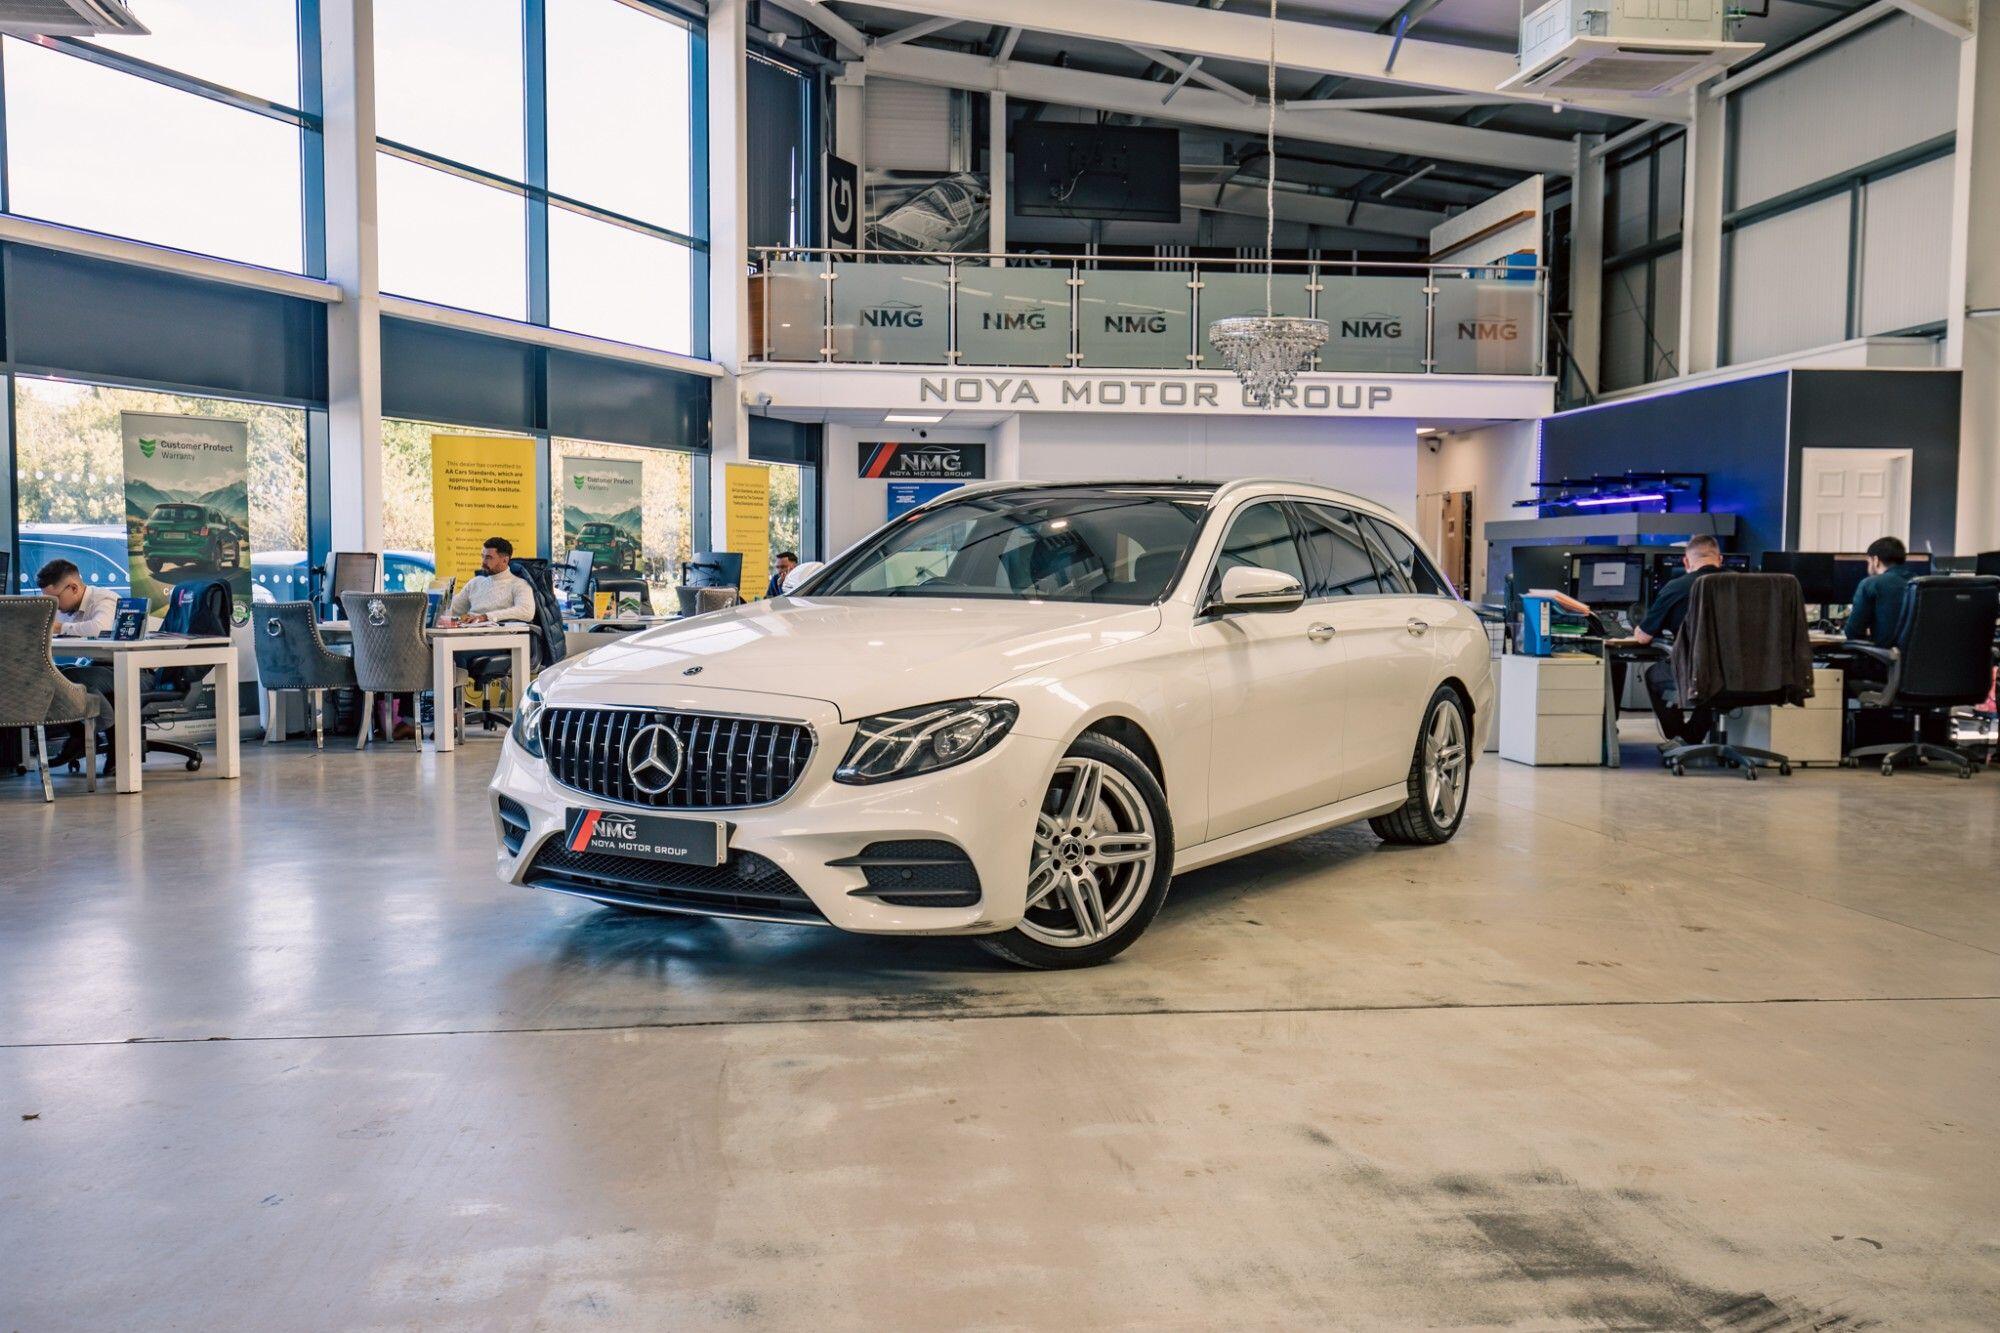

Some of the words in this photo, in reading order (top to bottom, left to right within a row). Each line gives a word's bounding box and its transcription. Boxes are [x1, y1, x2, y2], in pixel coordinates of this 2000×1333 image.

[859, 309, 924, 328] NMG
[982, 312, 1047, 330] NMG
[1104, 315, 1167, 334] NMG
[1341, 320, 1402, 339] NMG
[1457, 322, 1518, 341] NMG
[920, 377, 1040, 404] NOYA
[1062, 380, 1219, 407] MOTOR
[160, 440, 202, 450] Customer
[203, 442, 234, 452] Protect
[161, 451, 195, 461] Warranty
[900, 453, 962, 472] NMG
[592, 821, 637, 839] NMG
[591, 840, 616, 849] NOYA
[618, 843, 651, 852] MOTOR
[654, 846, 688, 856] GROUP
